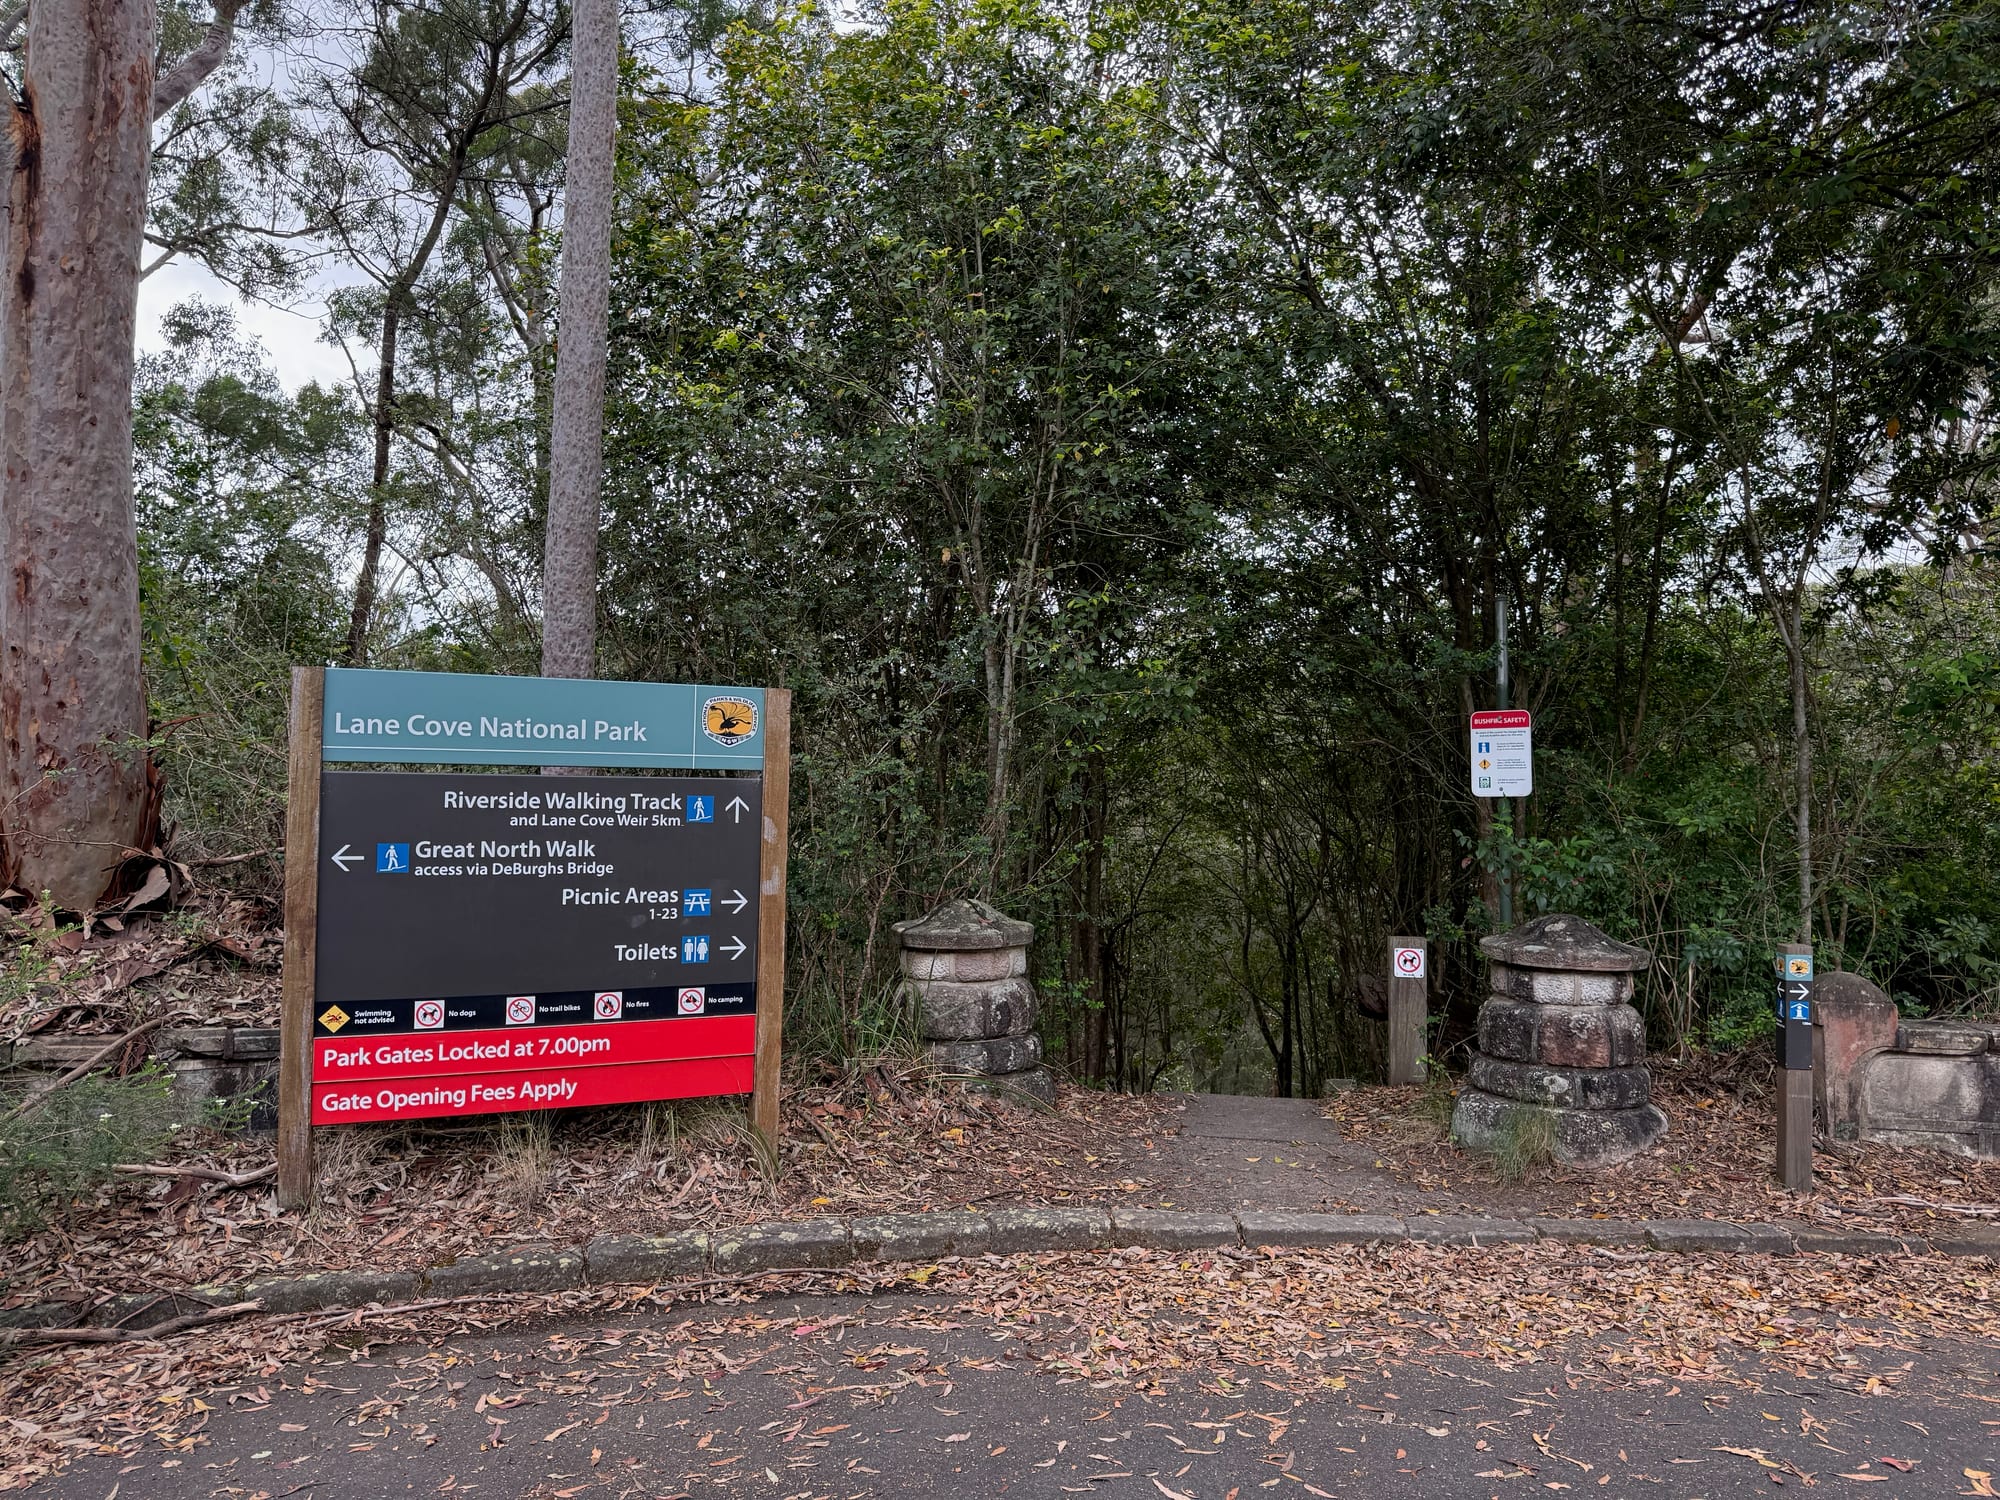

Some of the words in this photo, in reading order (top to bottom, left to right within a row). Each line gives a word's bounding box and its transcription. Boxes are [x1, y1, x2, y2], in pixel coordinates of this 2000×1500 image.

[335, 712, 400, 735] Lane
[407, 714, 473, 737] Cove
[480, 716, 587, 740] National
[594, 720, 647, 742] Park
[1503, 716, 1526, 724] SAFETY
[444, 791, 541, 810] Riverside
[545, 791, 627, 813] Walking
[630, 792, 683, 810] Track
[509, 814, 539, 827] and
[541, 813, 578, 827] Lane
[579, 813, 615, 827] Cove
[615, 813, 649, 827] Weir
[651, 814, 681, 827] 5km
[415, 840, 476, 859] Great
[480, 839, 541, 858] North
[546, 839, 596, 858] Walk
[414, 864, 463, 877] access
[466, 862, 488, 876] via
[492, 861, 564, 878] DeBurghs
[567, 861, 614, 877] Bridge
[561, 887, 621, 906] Picnic
[624, 887, 680, 905] Areas
[648, 907, 679, 921] 1-23
[614, 942, 678, 962] Toilets
[635, 1000, 650, 1008] fires
[717, 995, 744, 1005] camping
[354, 1009, 392, 1019] Swimming
[459, 1009, 477, 1018] dogs
[549, 1004, 563, 1012] trail
[563, 1004, 581, 1012] bikes
[368, 1015, 395, 1025] advised
[323, 1047, 372, 1068] Park
[375, 1046, 434, 1065] Gates
[438, 1039, 510, 1062] Locked
[513, 1041, 534, 1057] at
[538, 1036, 611, 1057] 7.00pm
[321, 1092, 373, 1112] Gate
[376, 1086, 466, 1112] Opening
[471, 1083, 516, 1102] Fees
[520, 1078, 578, 1102] Apply
